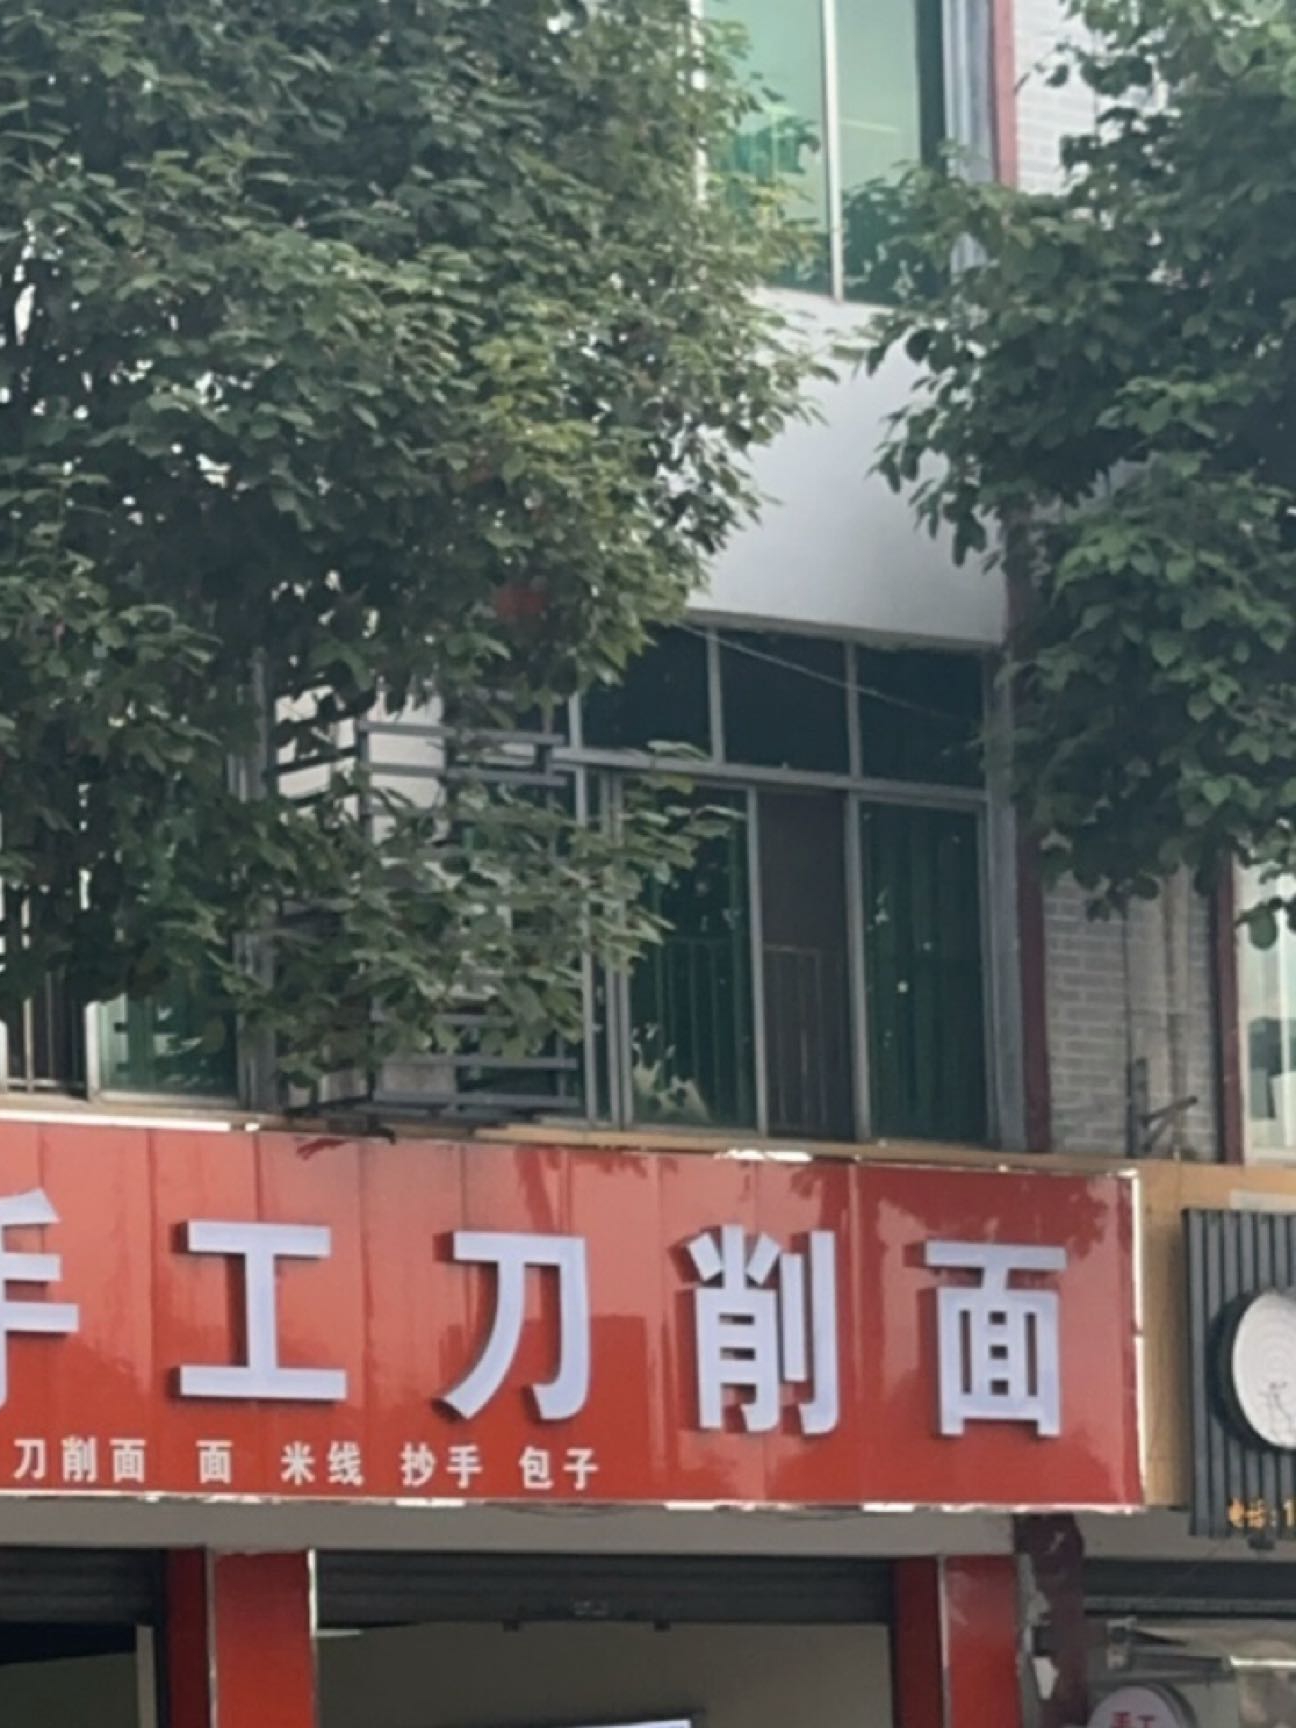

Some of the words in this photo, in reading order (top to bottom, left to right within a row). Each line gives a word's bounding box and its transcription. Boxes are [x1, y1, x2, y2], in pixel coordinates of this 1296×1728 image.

[13, 1436, 147, 1484] 刀削面
[196, 1439, 233, 1484] 面
[280, 1440, 365, 1487] 米线
[399, 1441, 483, 1490] 抄手
[518, 1446, 599, 1491] 包子
